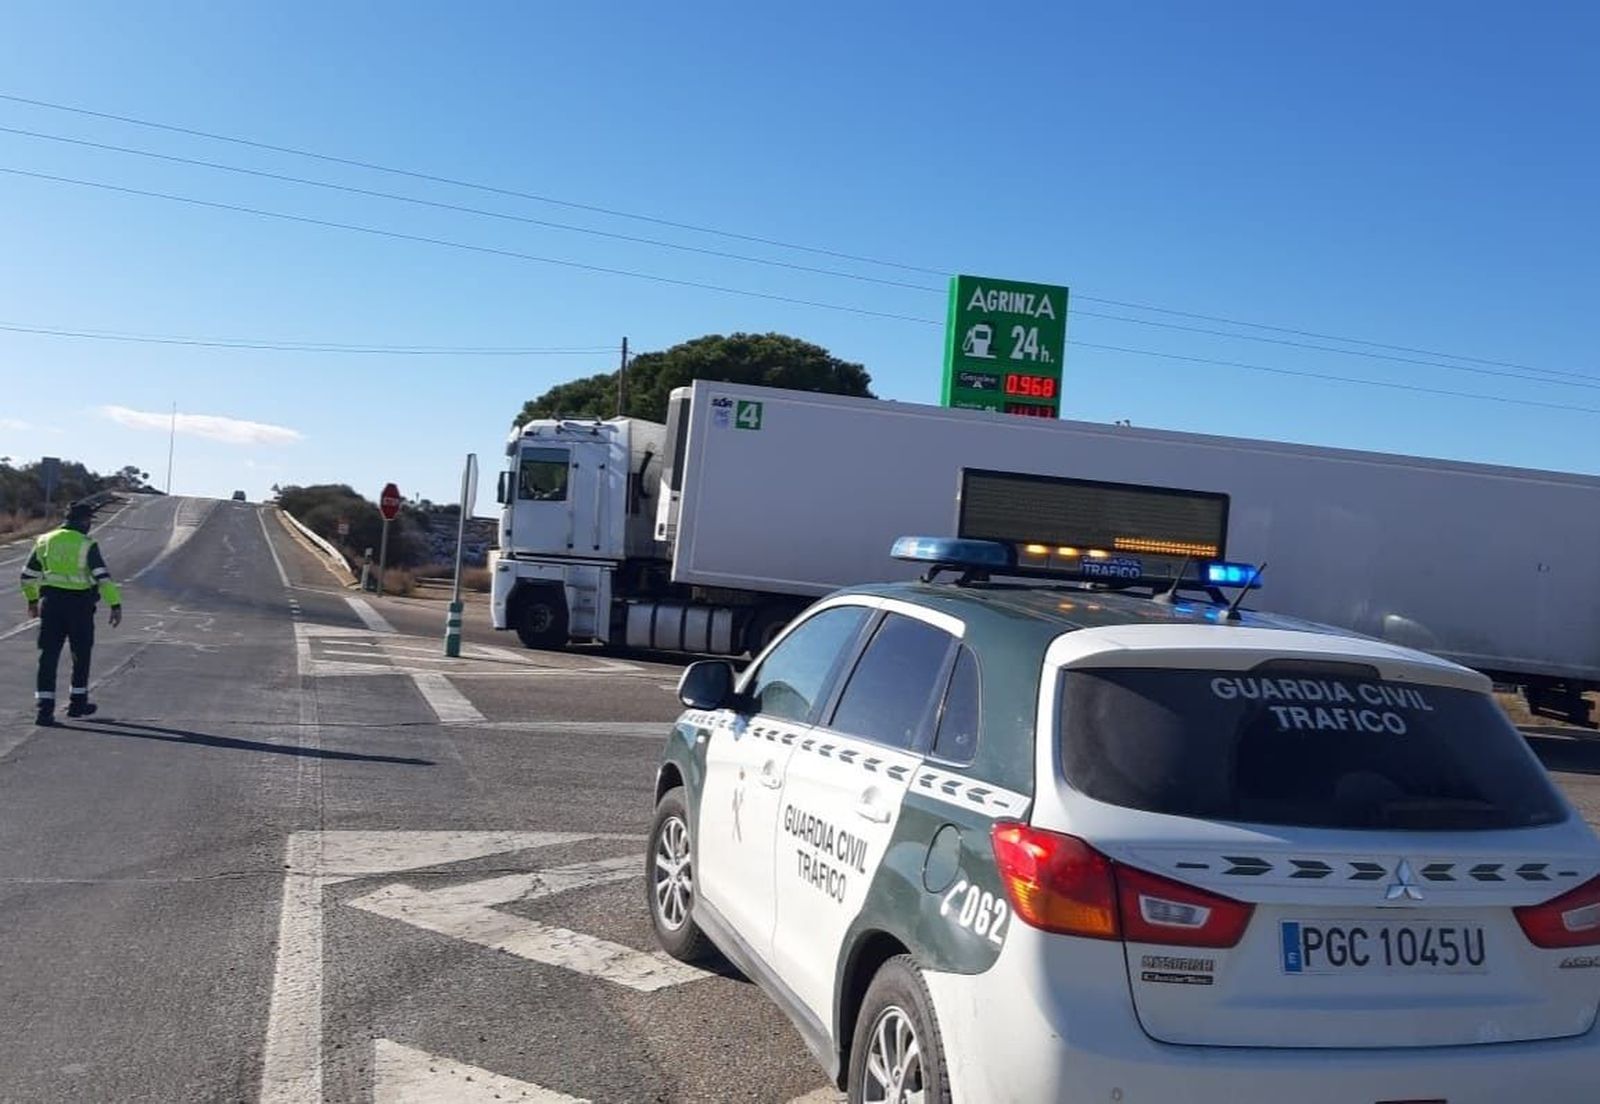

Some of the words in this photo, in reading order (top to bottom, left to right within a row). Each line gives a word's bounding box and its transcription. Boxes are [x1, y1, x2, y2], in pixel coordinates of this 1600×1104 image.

[966, 286, 1055, 320] AGRINZA
[739, 403, 759, 428] 4
[1210, 677, 1355, 702] GUARDIA
[1358, 684, 1435, 711] CIVIL
[1270, 705, 1407, 735] TRAFICO
[785, 804, 834, 855] GUARDIA
[837, 830, 868, 874] CIVIL
[959, 885, 1007, 945] 062
[1303, 927, 1370, 966] PGC
